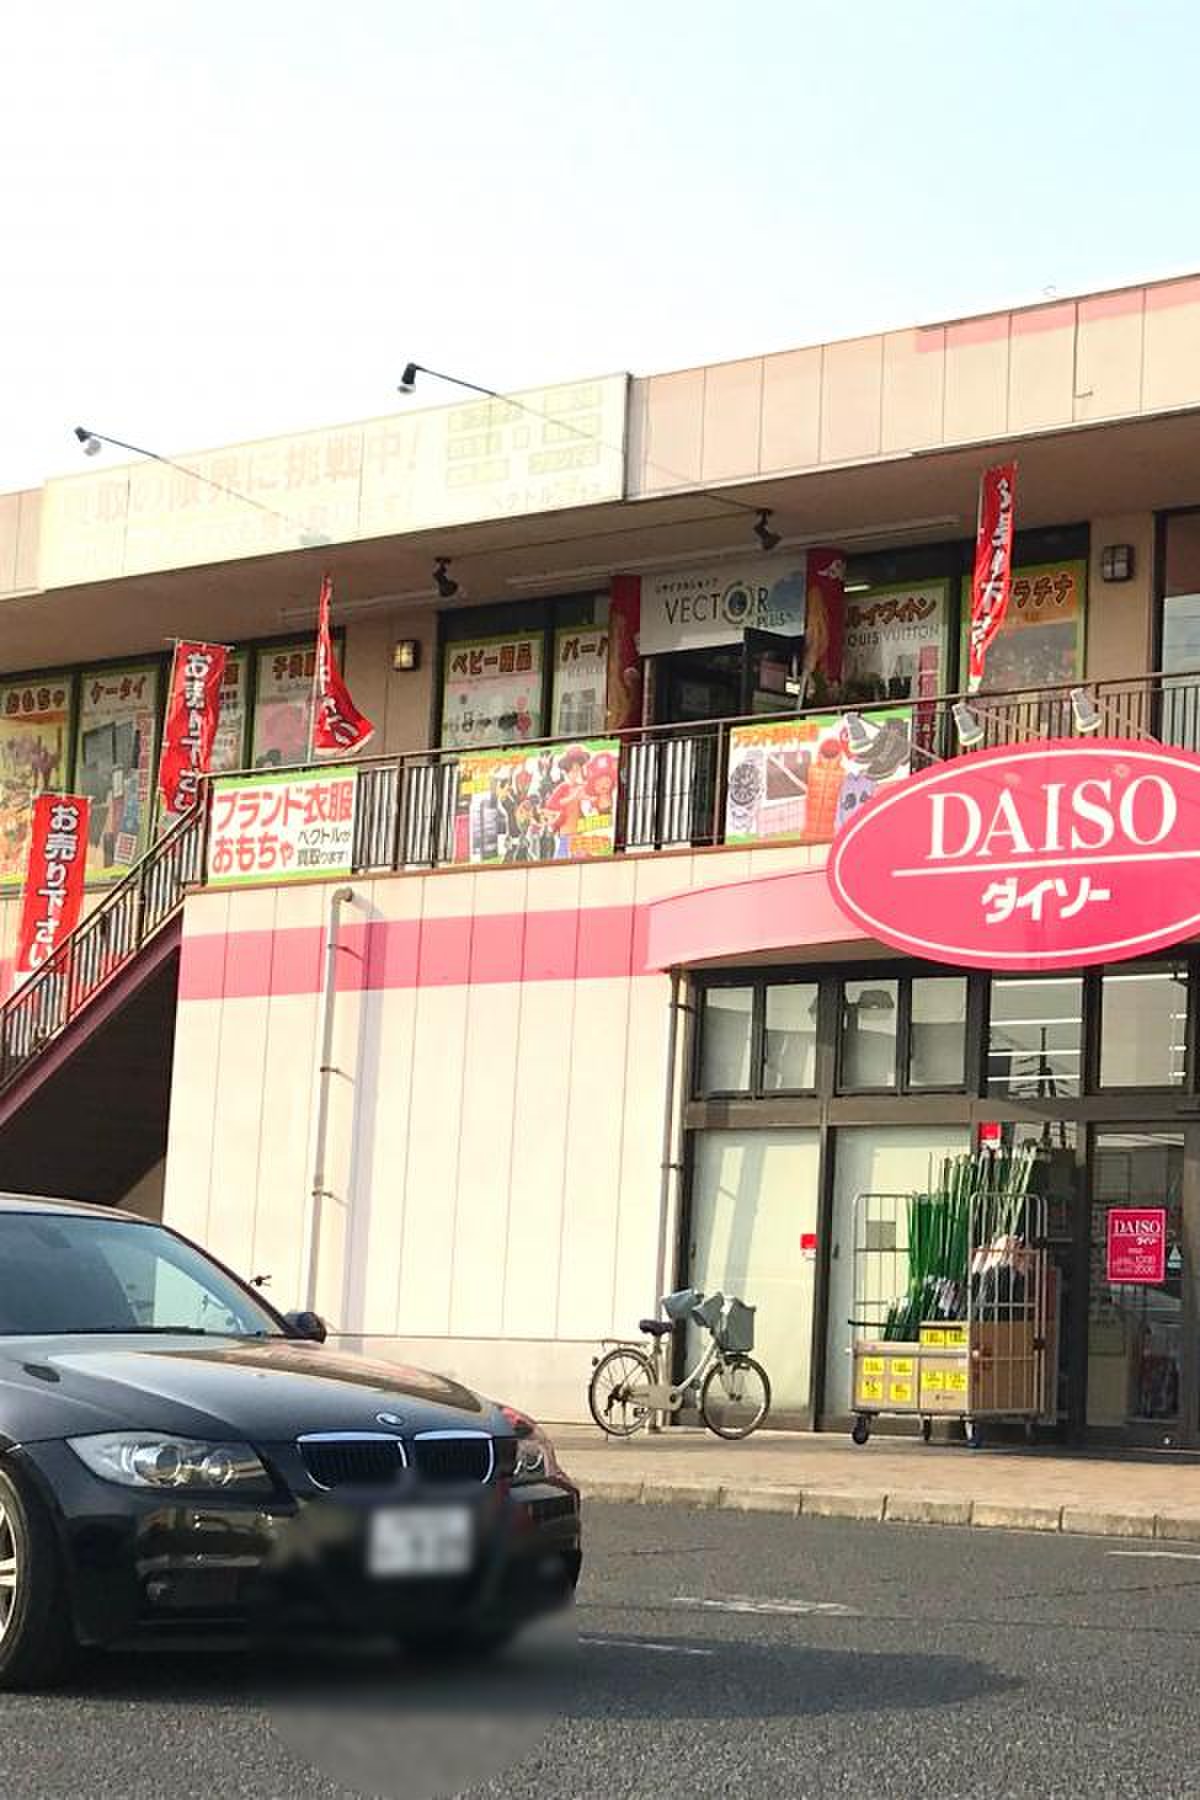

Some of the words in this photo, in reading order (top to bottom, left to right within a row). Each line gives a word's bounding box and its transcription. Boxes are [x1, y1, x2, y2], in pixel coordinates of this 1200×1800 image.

[1009, 573, 1073, 608] ラチナ
[216, 779, 353, 832] ブランド衣服
[925, 774, 1178, 860] DAISO
[212, 831, 295, 874] おもちゃ
[29, 804, 79, 970] お売り下さい
[981, 876, 1111, 924] ダイソー
[1114, 1219, 1161, 1234] DAISO
